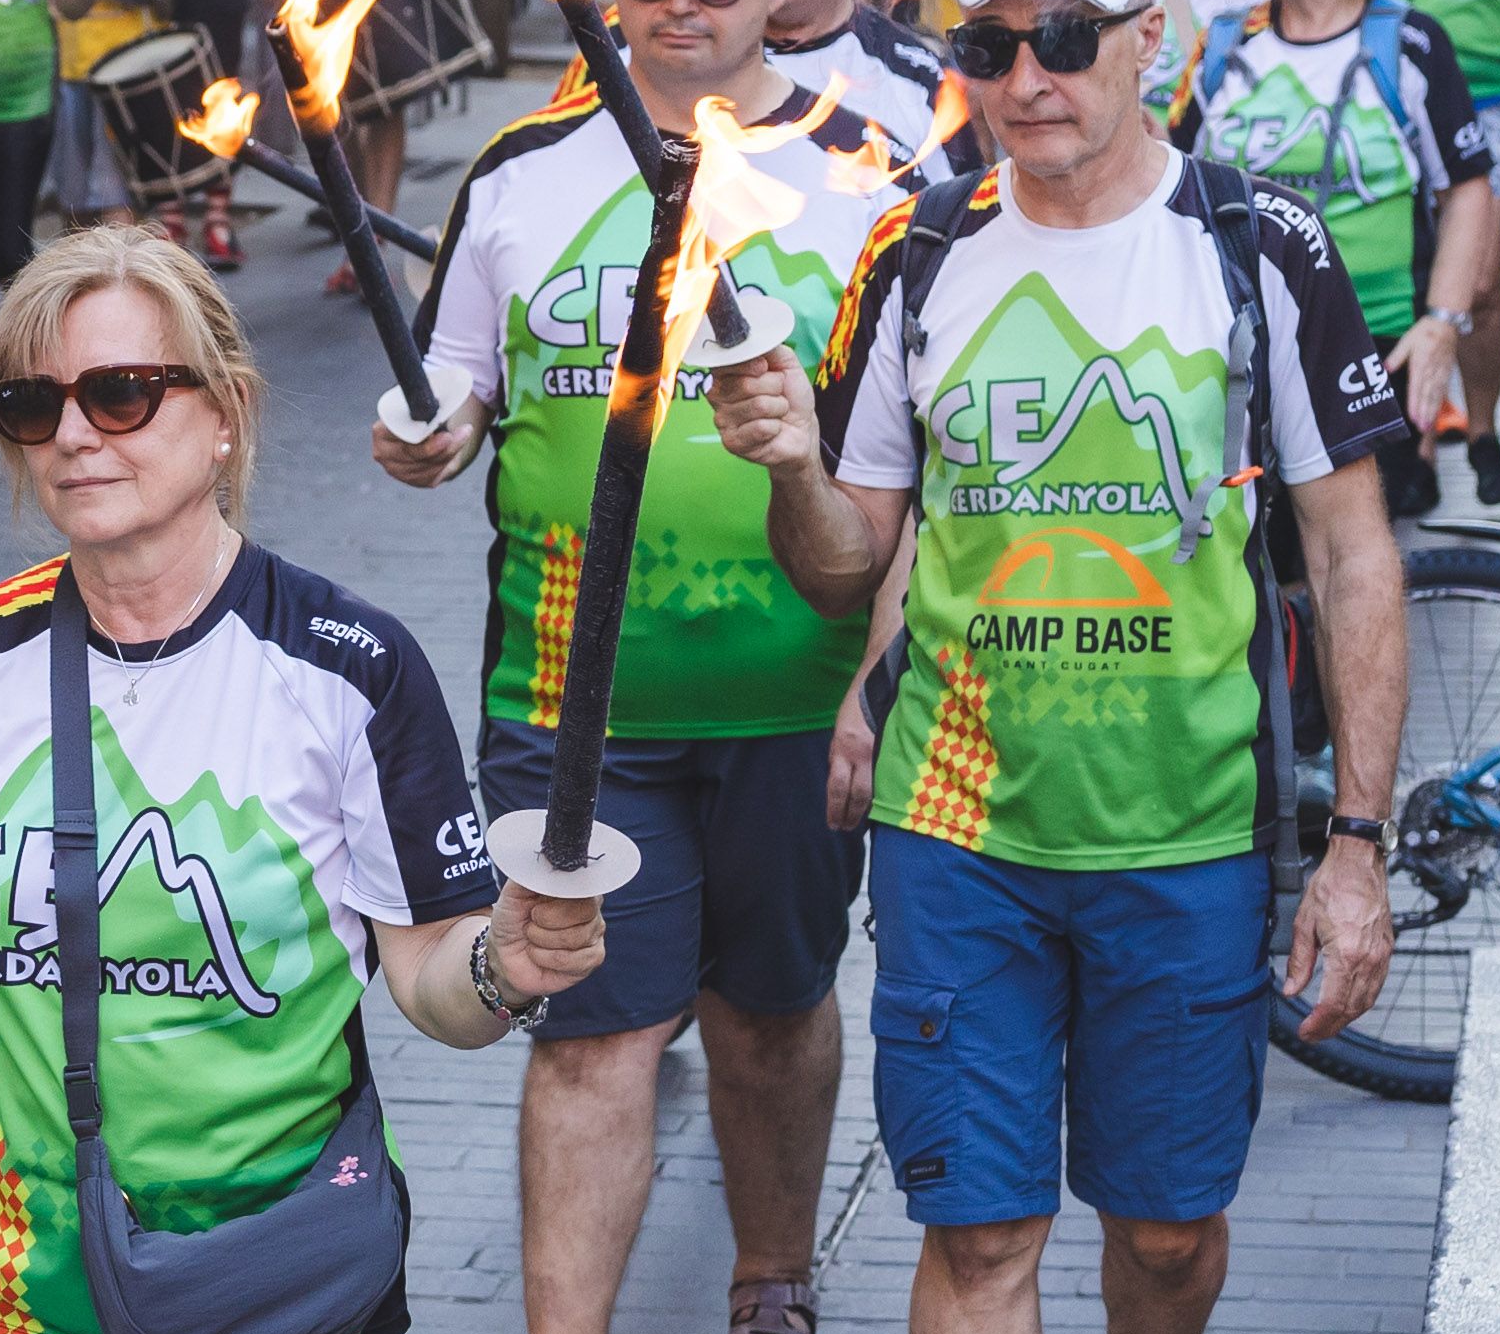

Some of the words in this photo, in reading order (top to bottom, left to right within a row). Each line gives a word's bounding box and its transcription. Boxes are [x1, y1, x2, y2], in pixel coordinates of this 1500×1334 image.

[1253, 191, 1331, 270] SPORTY
[308, 615, 387, 659] SPORTY
[966, 613, 1064, 653] CAMP
[1075, 615, 1173, 655] BASE
[1003, 659, 1047, 671] SANT
